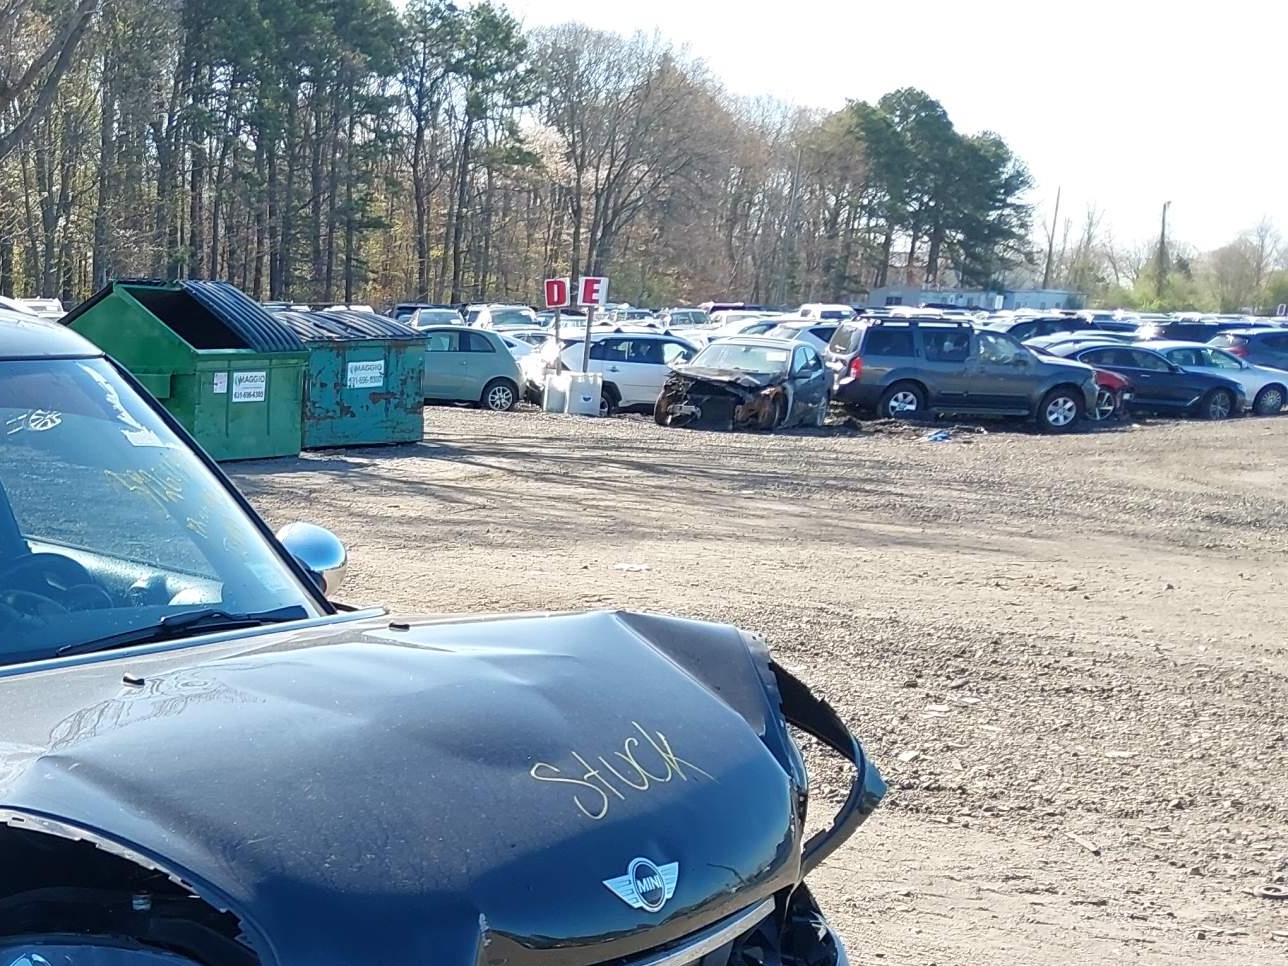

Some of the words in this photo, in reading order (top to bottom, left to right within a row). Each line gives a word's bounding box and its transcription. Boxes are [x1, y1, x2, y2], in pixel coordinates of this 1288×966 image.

[546, 280, 567, 307] D
[582, 279, 601, 304] E
[237, 375, 265, 384] MAGGIO
[636, 875, 662, 894] MINI
